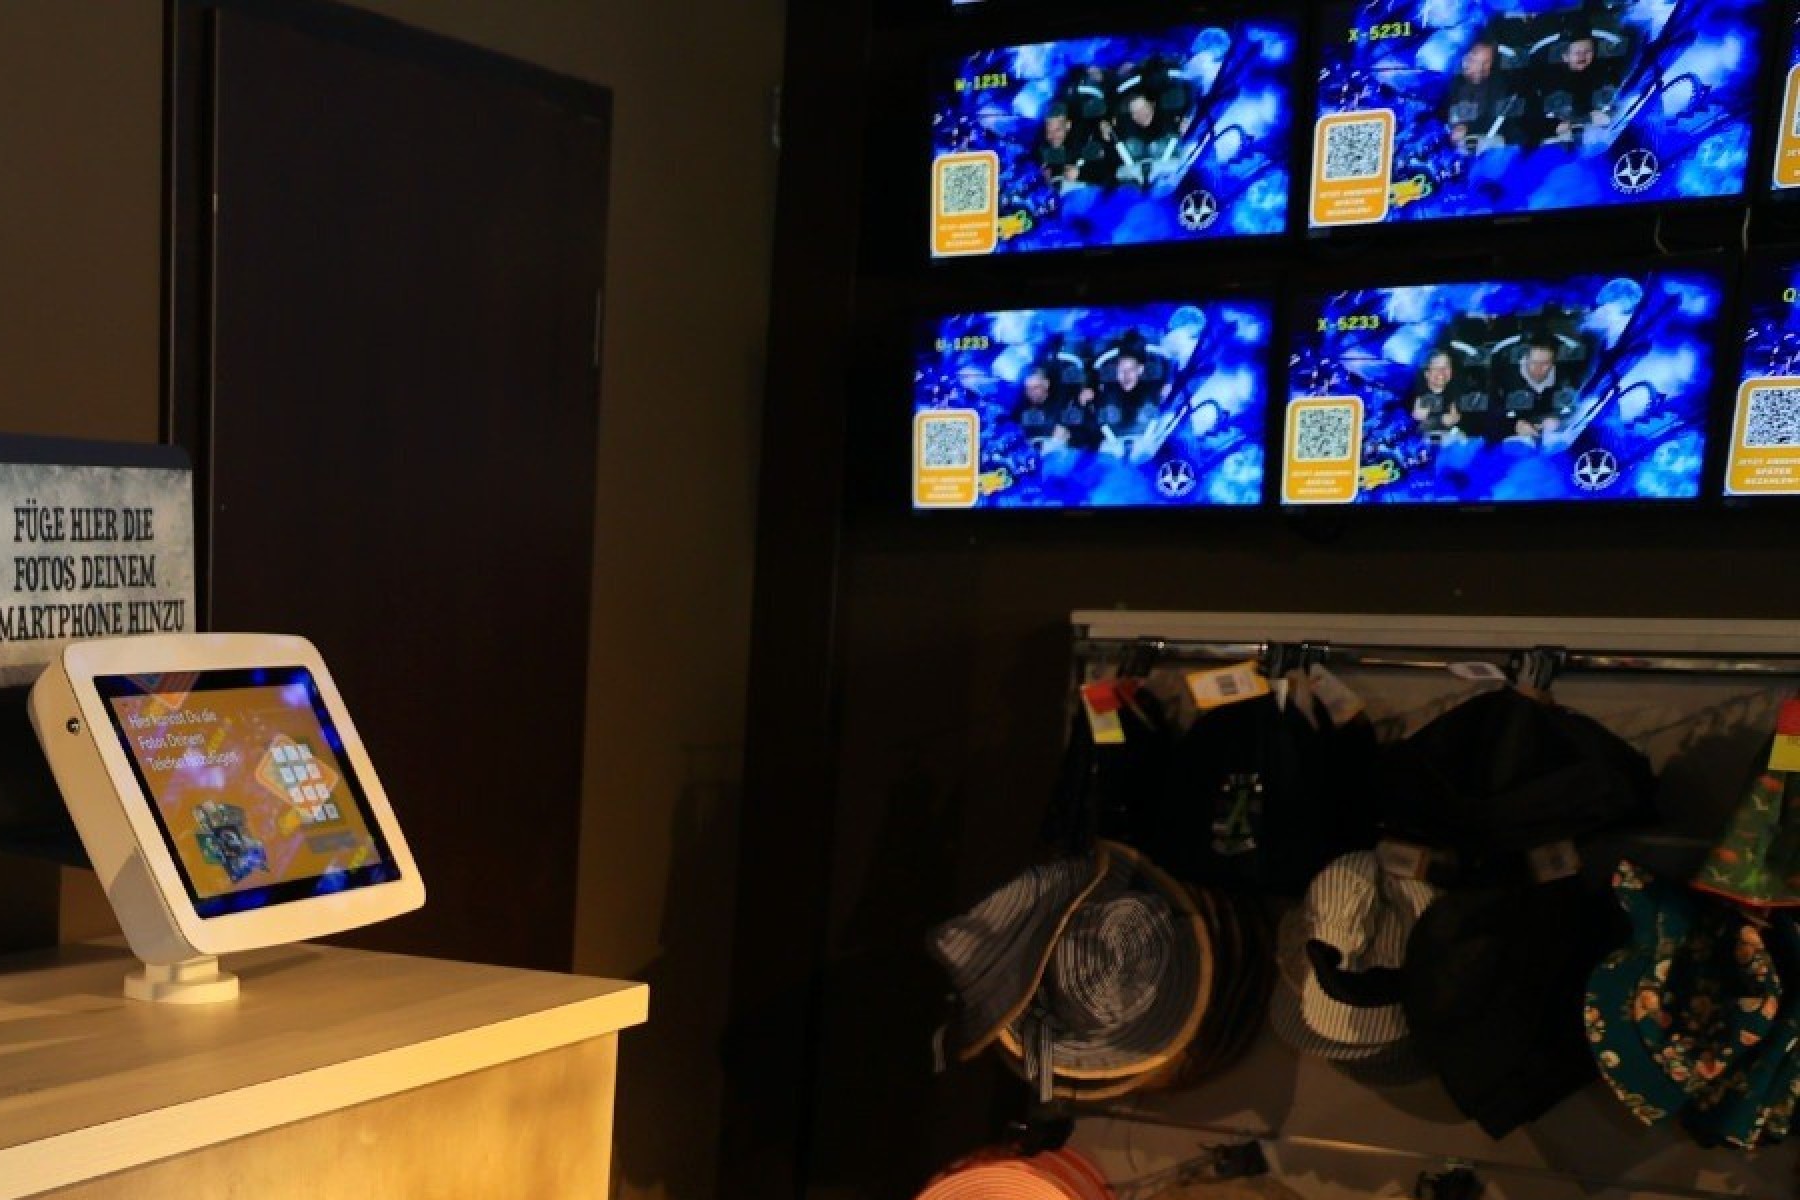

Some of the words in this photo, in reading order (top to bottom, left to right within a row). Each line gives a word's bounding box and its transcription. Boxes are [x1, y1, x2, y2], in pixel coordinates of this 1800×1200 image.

[13, 498, 65, 542] FÜGE
[70, 507, 118, 542] HIER
[122, 507, 154, 541] DIE
[13, 555, 76, 592] FOTOS
[81, 554, 156, 590] DEINEM
[127, 600, 185, 633] HINZU
